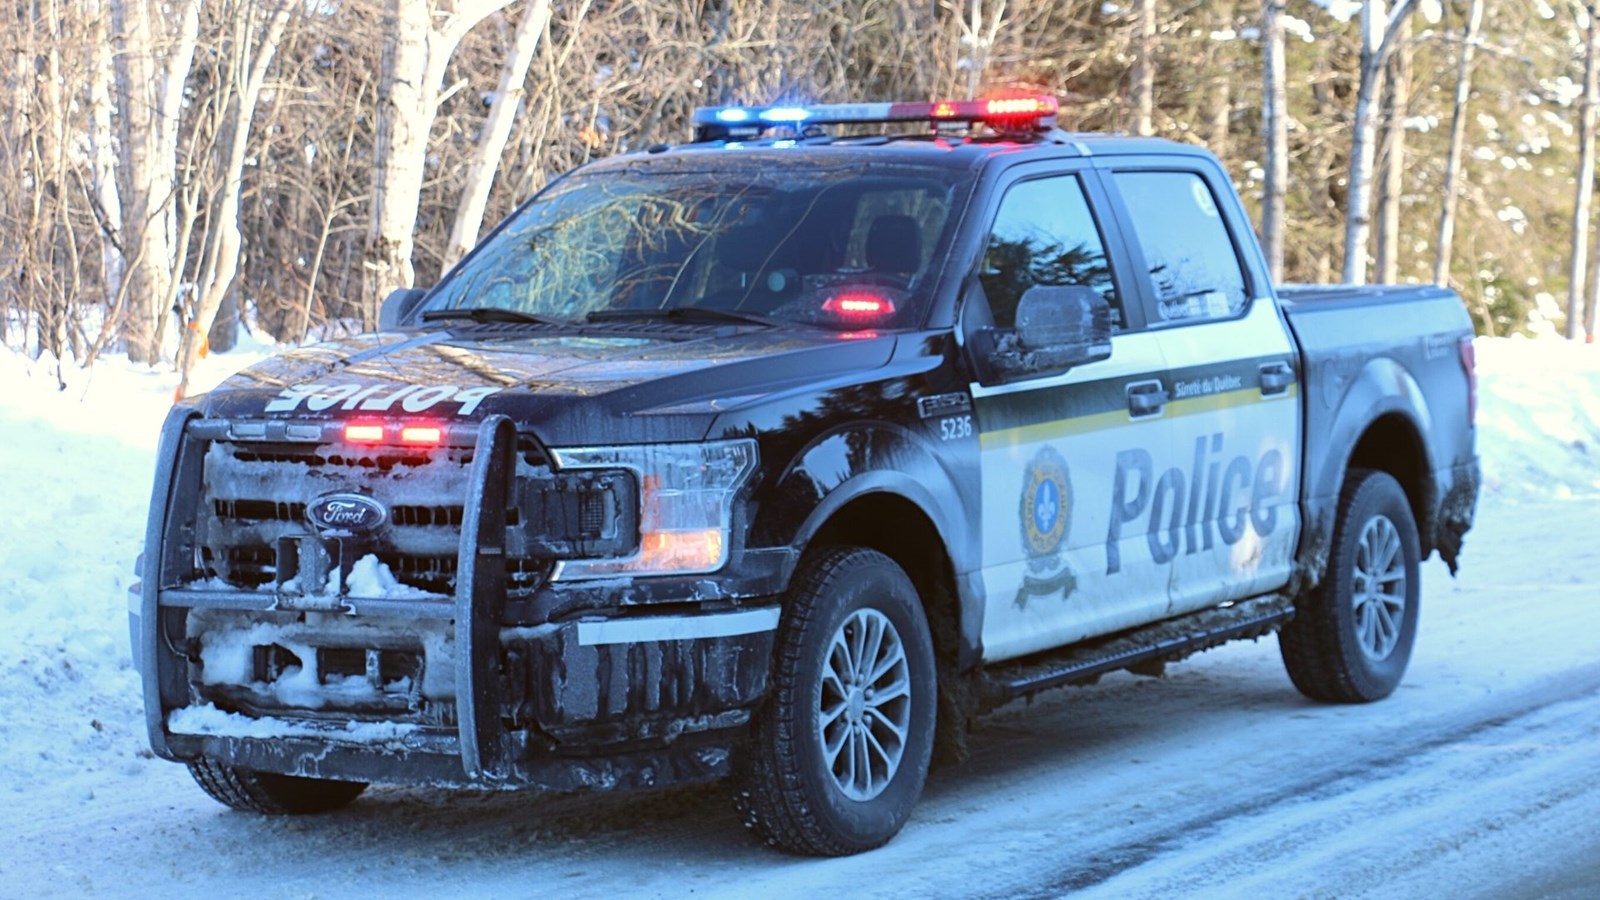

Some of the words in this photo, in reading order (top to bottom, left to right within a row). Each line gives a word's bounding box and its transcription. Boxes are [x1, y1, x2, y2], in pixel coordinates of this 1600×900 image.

[1175, 379, 1202, 397] Sûreté
[1203, 379, 1213, 393] du
[1215, 375, 1241, 392] Québec
[941, 415, 972, 441] 5236
[323, 501, 367, 524] Ford
[1106, 432, 1284, 576] Police
